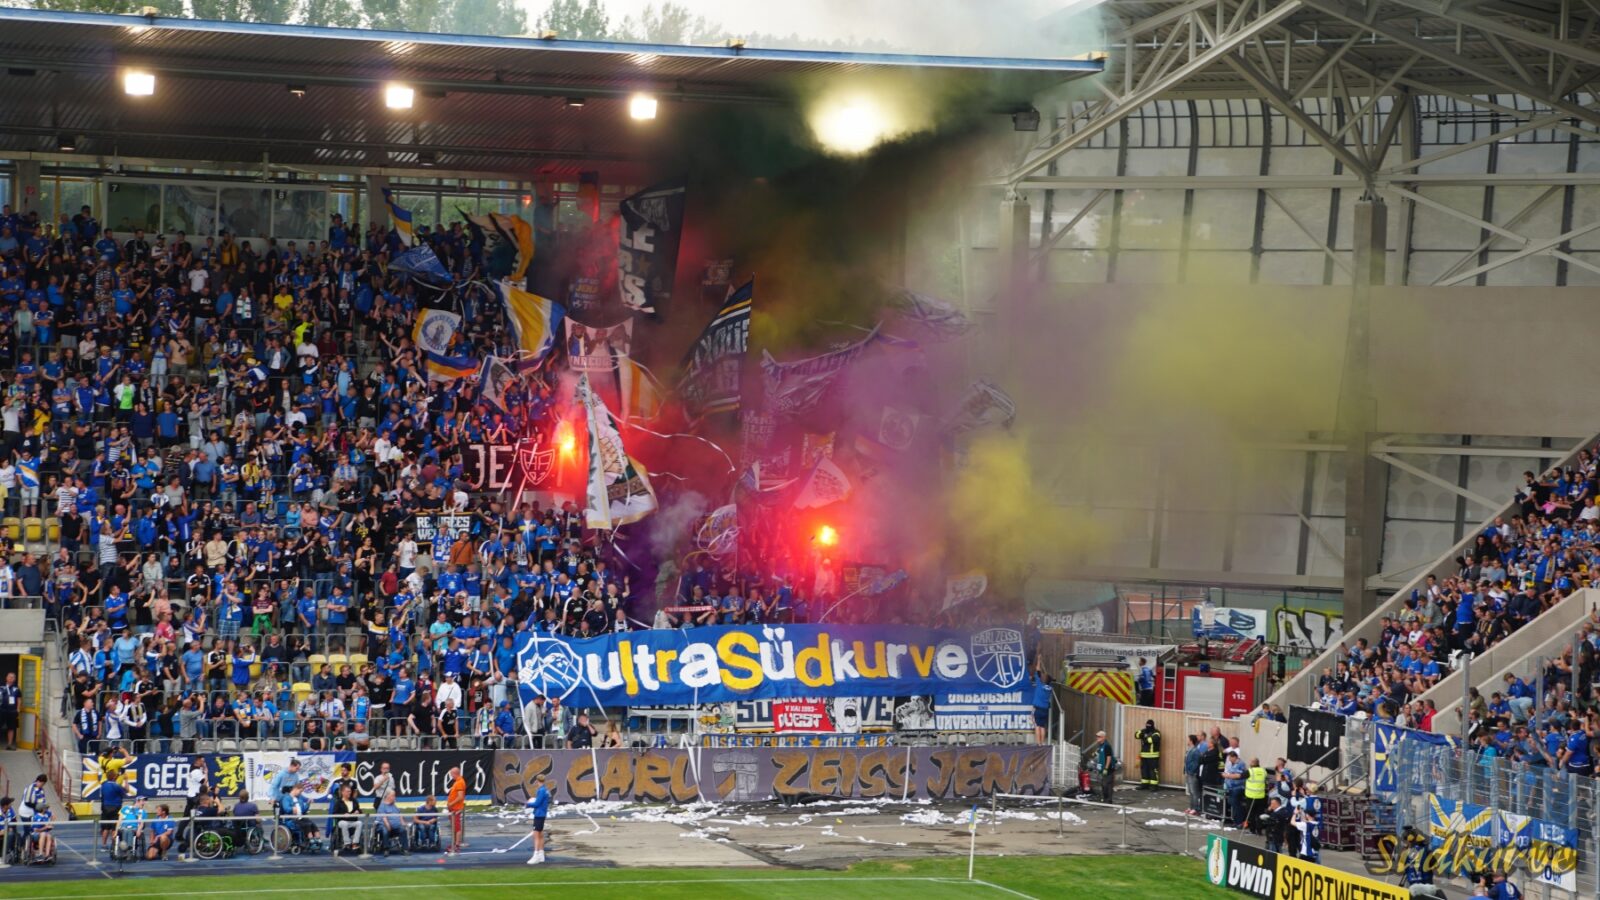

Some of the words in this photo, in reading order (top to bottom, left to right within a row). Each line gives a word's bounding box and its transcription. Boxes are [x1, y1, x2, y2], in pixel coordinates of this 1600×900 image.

[1296, 719, 1330, 748] Jena
[356, 760, 486, 796] Salfeld
[566, 754, 700, 803] CARL
[771, 751, 917, 799] ZEISS
[927, 747, 1049, 798] JENA
[1228, 849, 1274, 896] bwin
[1281, 864, 1403, 900] SPORTWE
